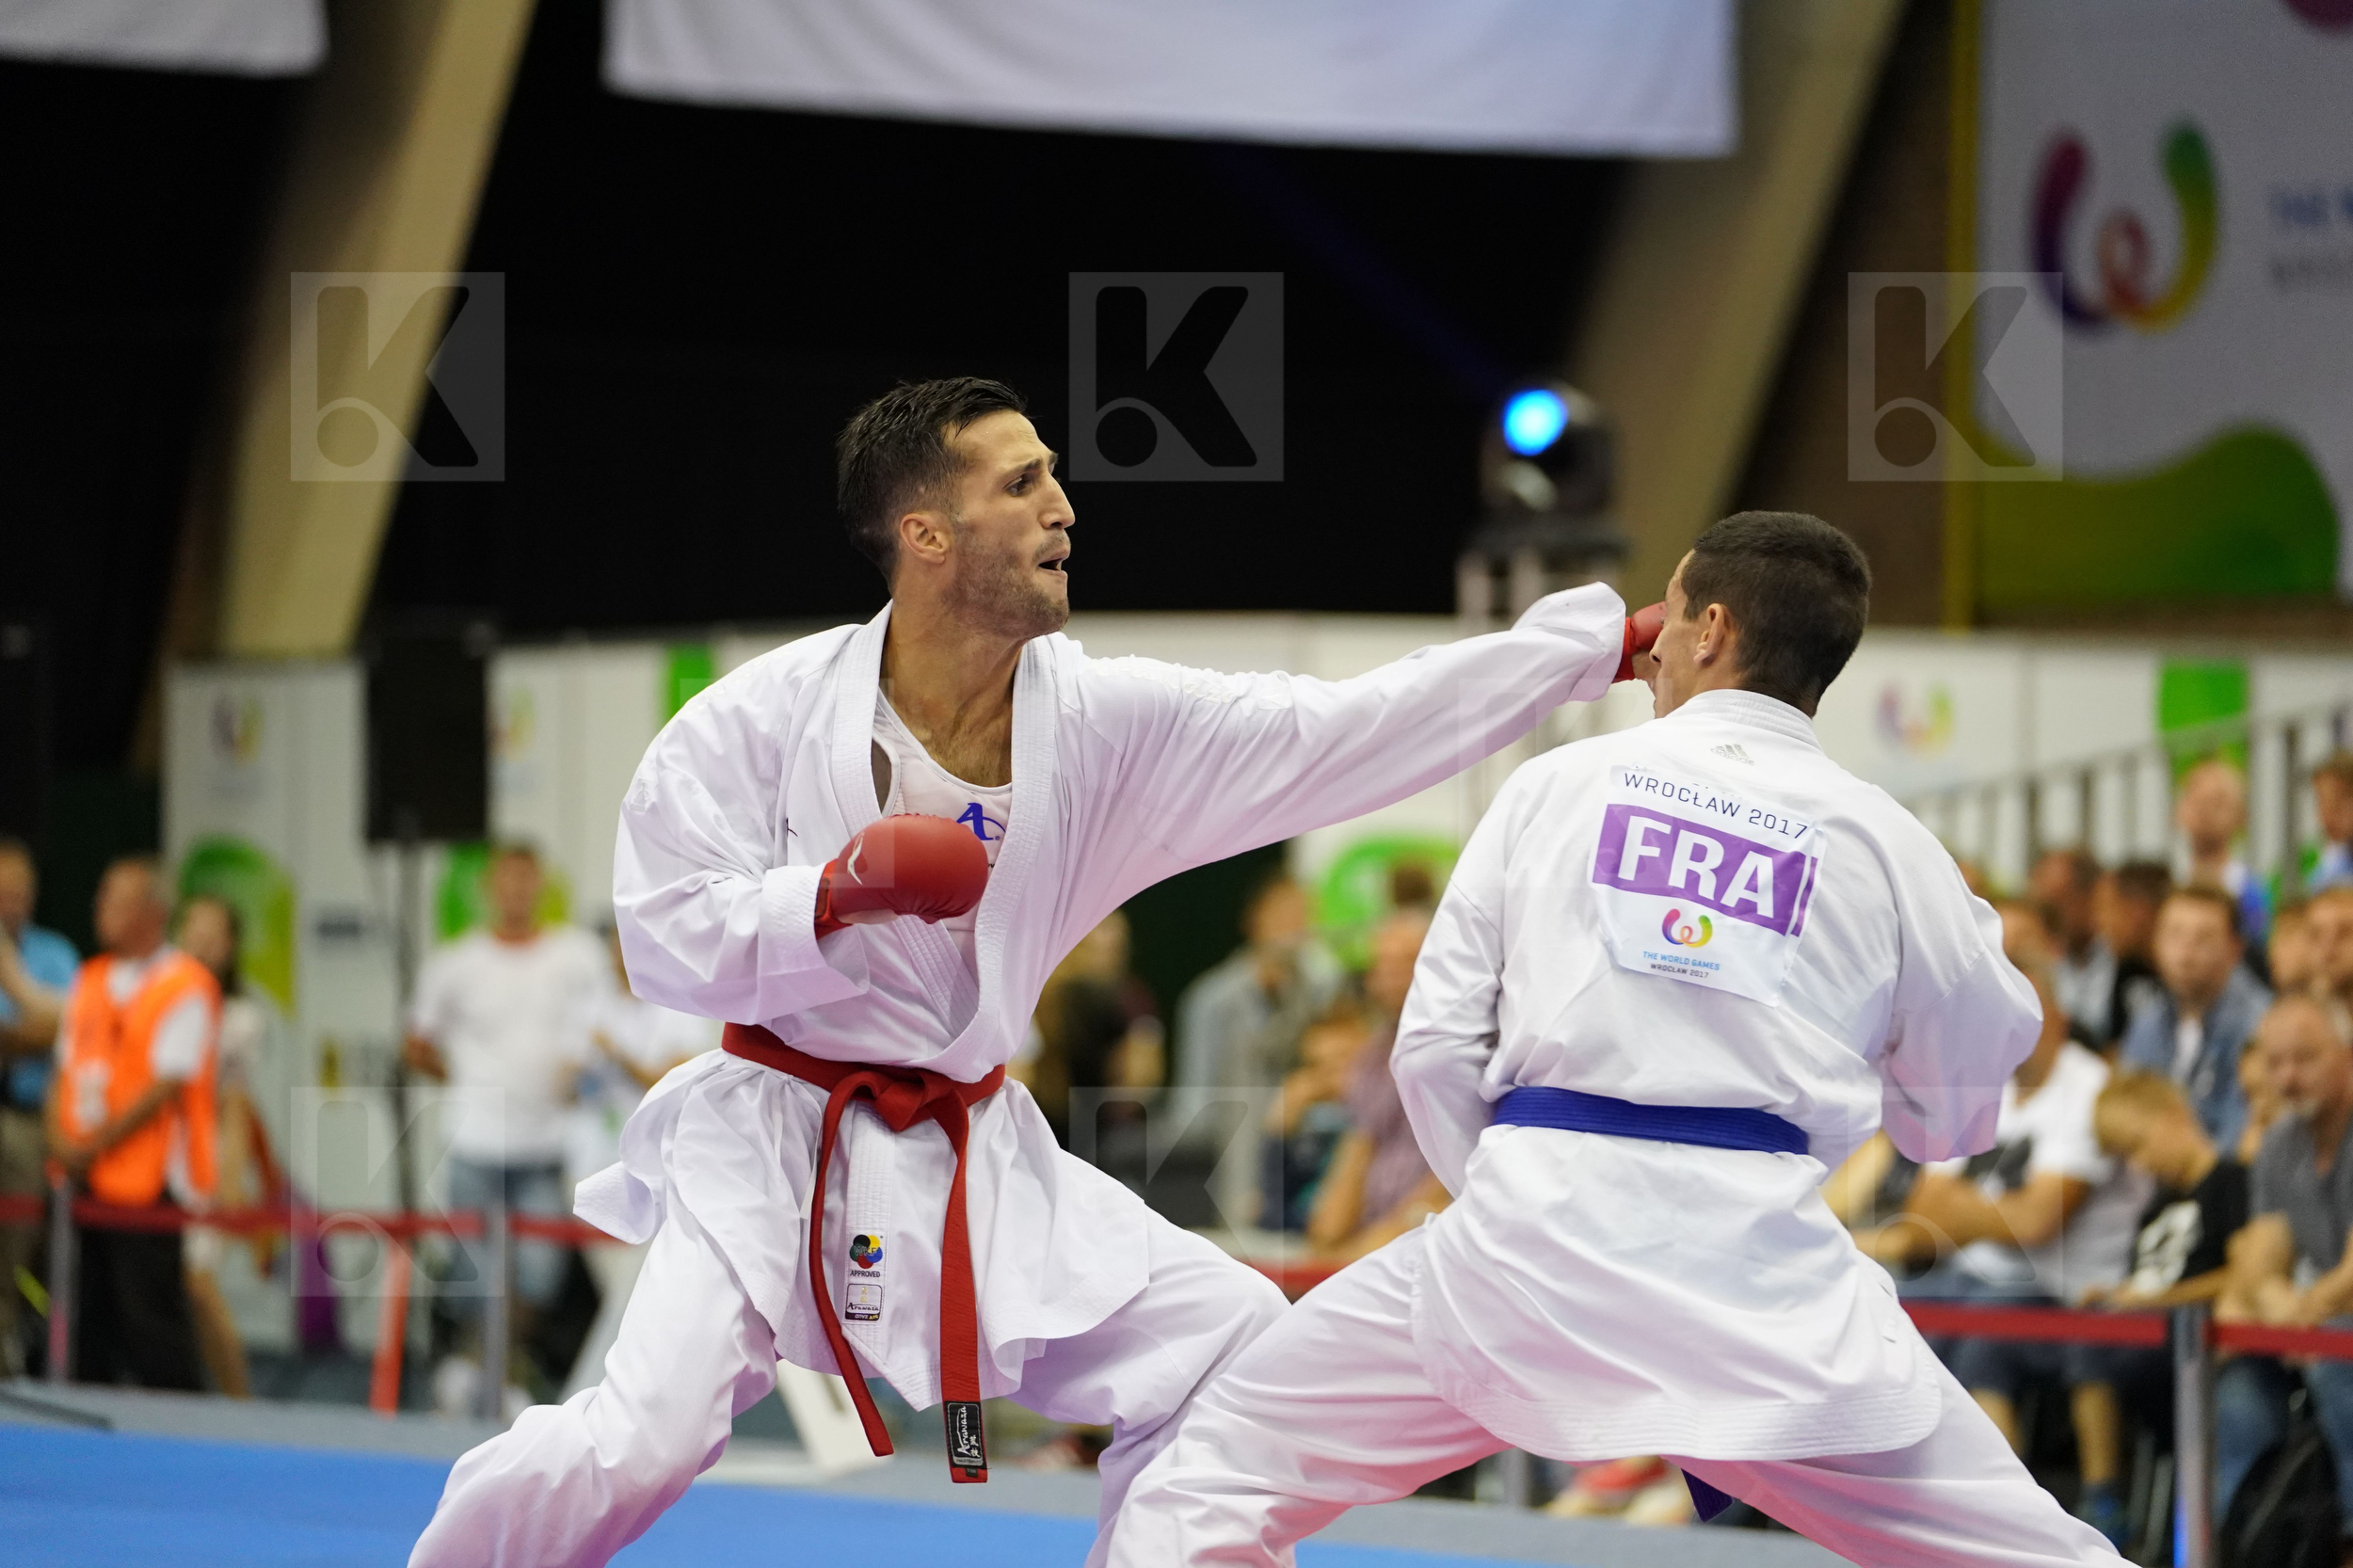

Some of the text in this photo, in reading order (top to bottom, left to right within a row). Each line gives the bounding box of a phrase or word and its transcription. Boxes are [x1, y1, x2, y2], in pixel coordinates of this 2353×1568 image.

[1625, 773, 1808, 840] WROCŁAW 2017
[1618, 815, 1774, 919] FRA
[1642, 951, 1721, 971] THE WORLD GAMES
[1689, 968, 1709, 979] 2017
[956, 1405, 972, 1457] Arawaza
